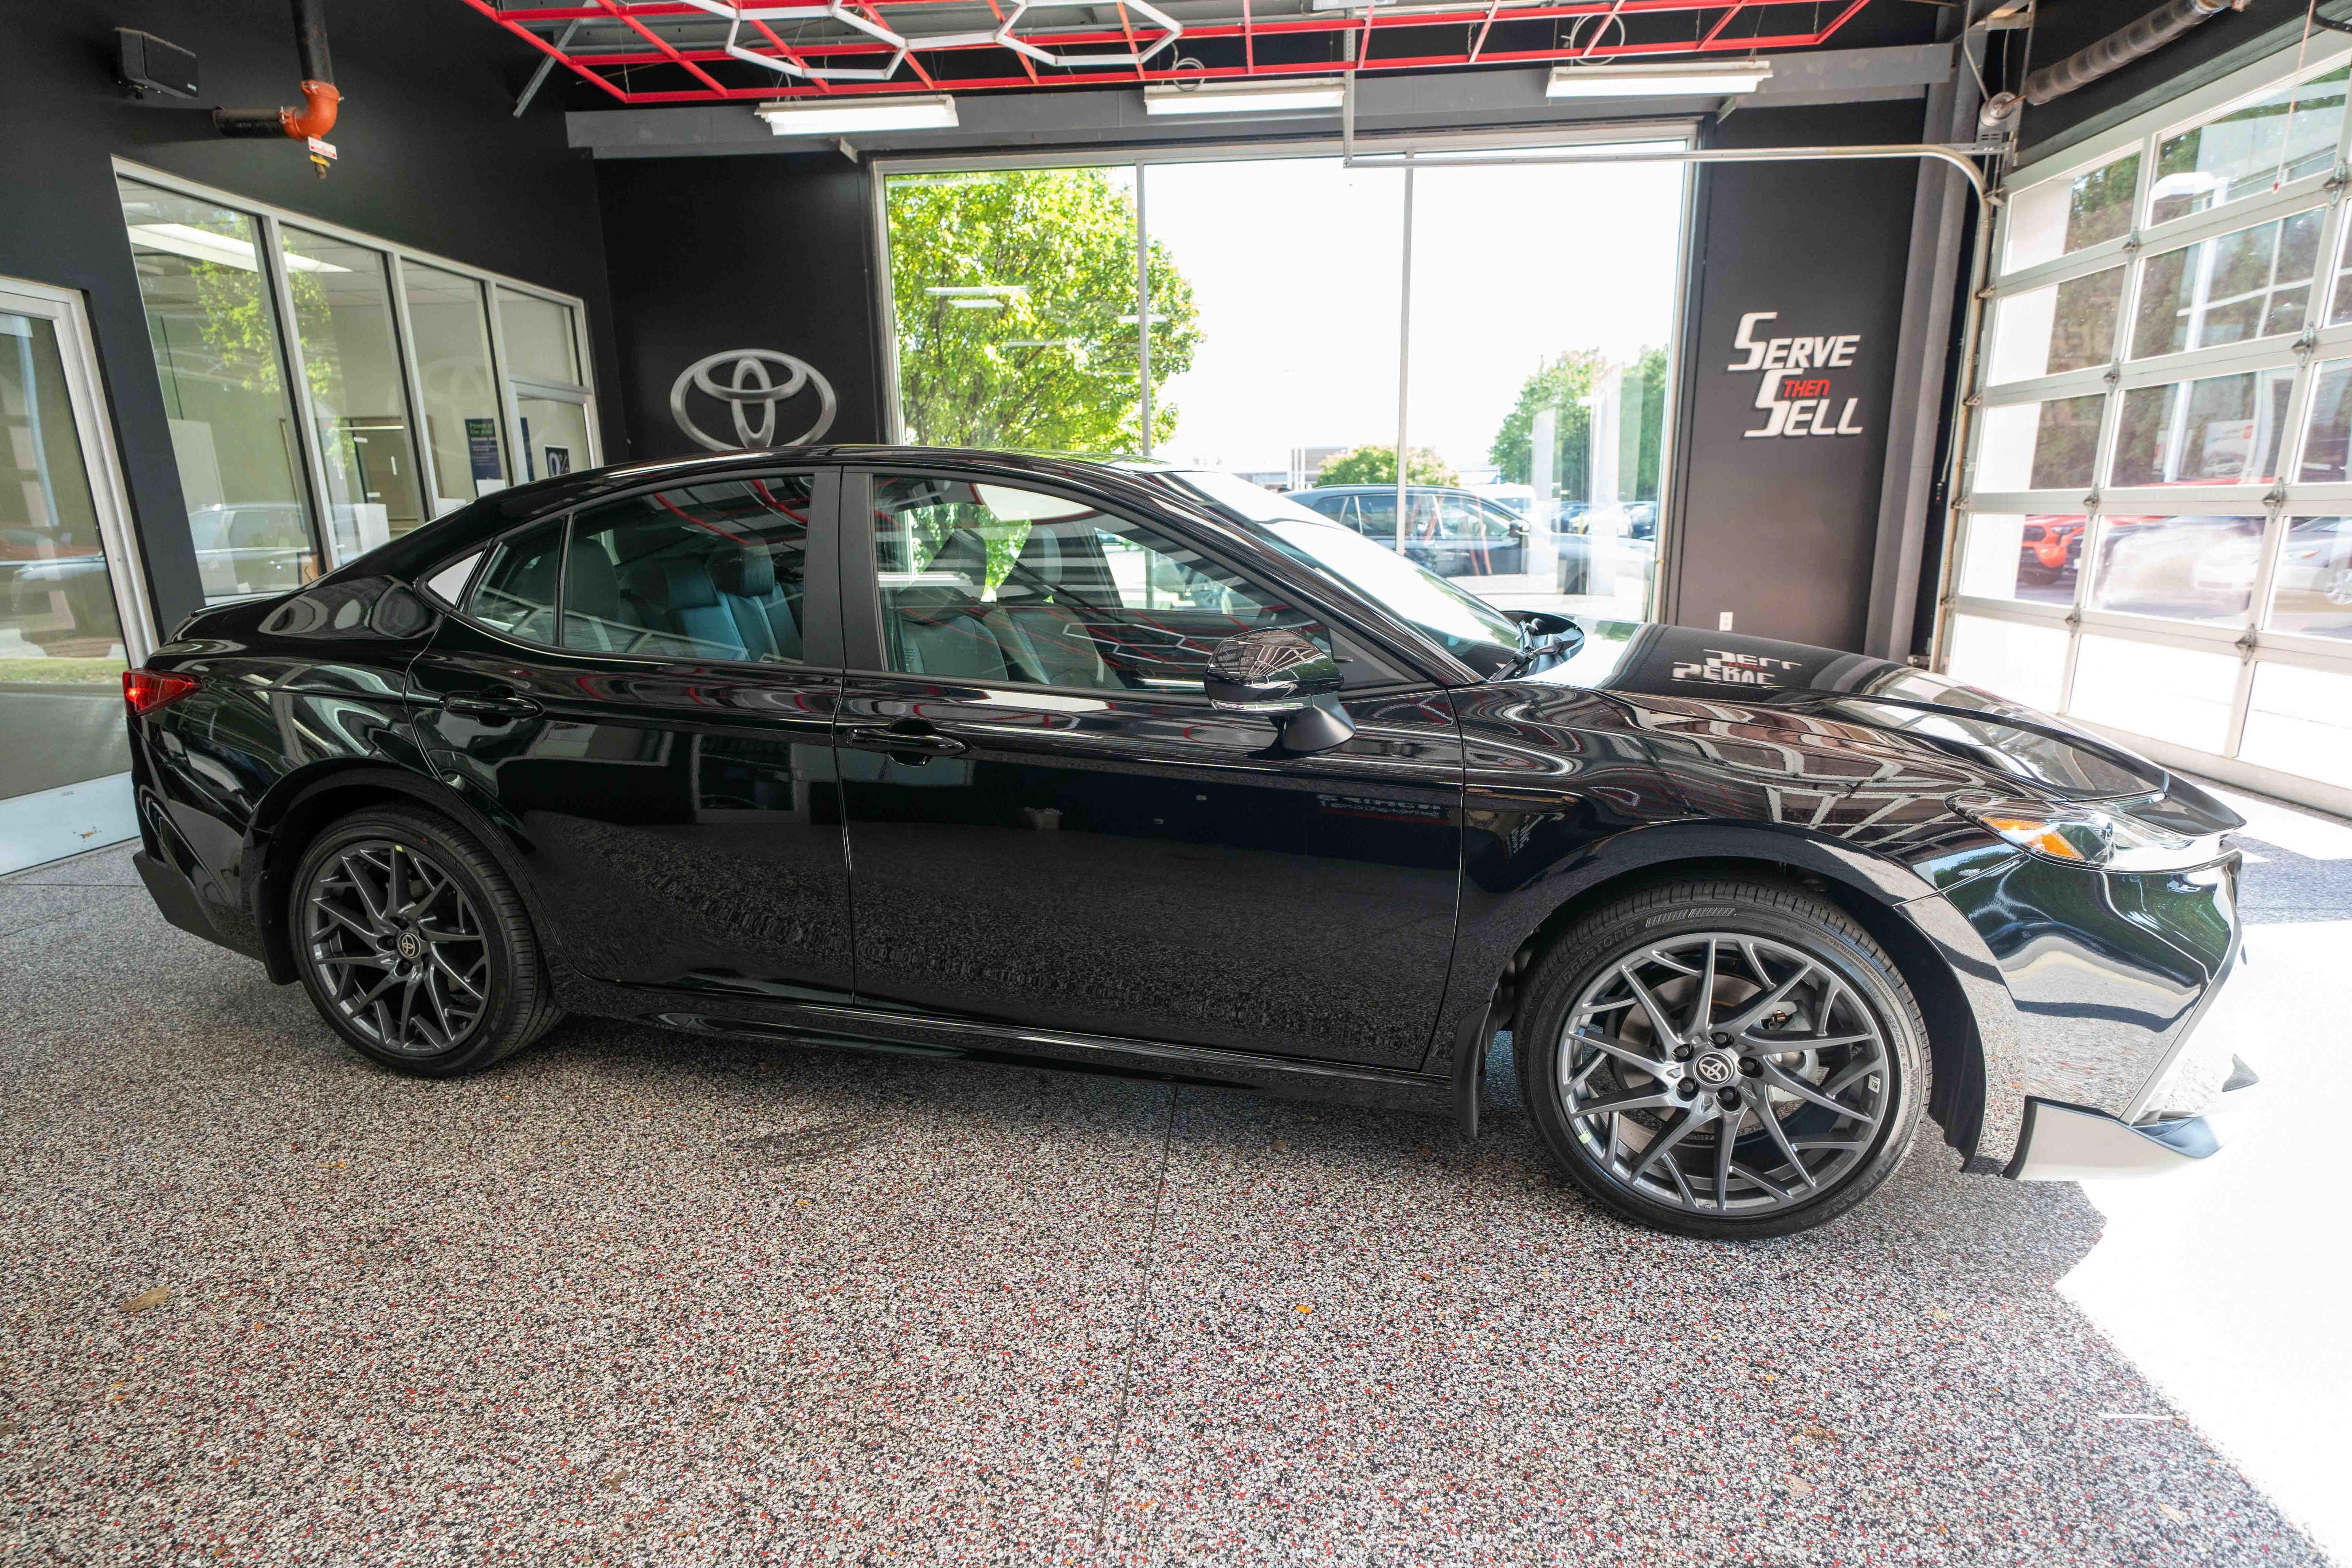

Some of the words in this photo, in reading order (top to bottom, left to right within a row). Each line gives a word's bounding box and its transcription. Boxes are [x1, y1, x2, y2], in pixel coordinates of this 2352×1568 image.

[1727, 312, 1861, 371] SERVE
[1744, 368, 1863, 437] SELL
[1784, 379, 1830, 397] THEN
